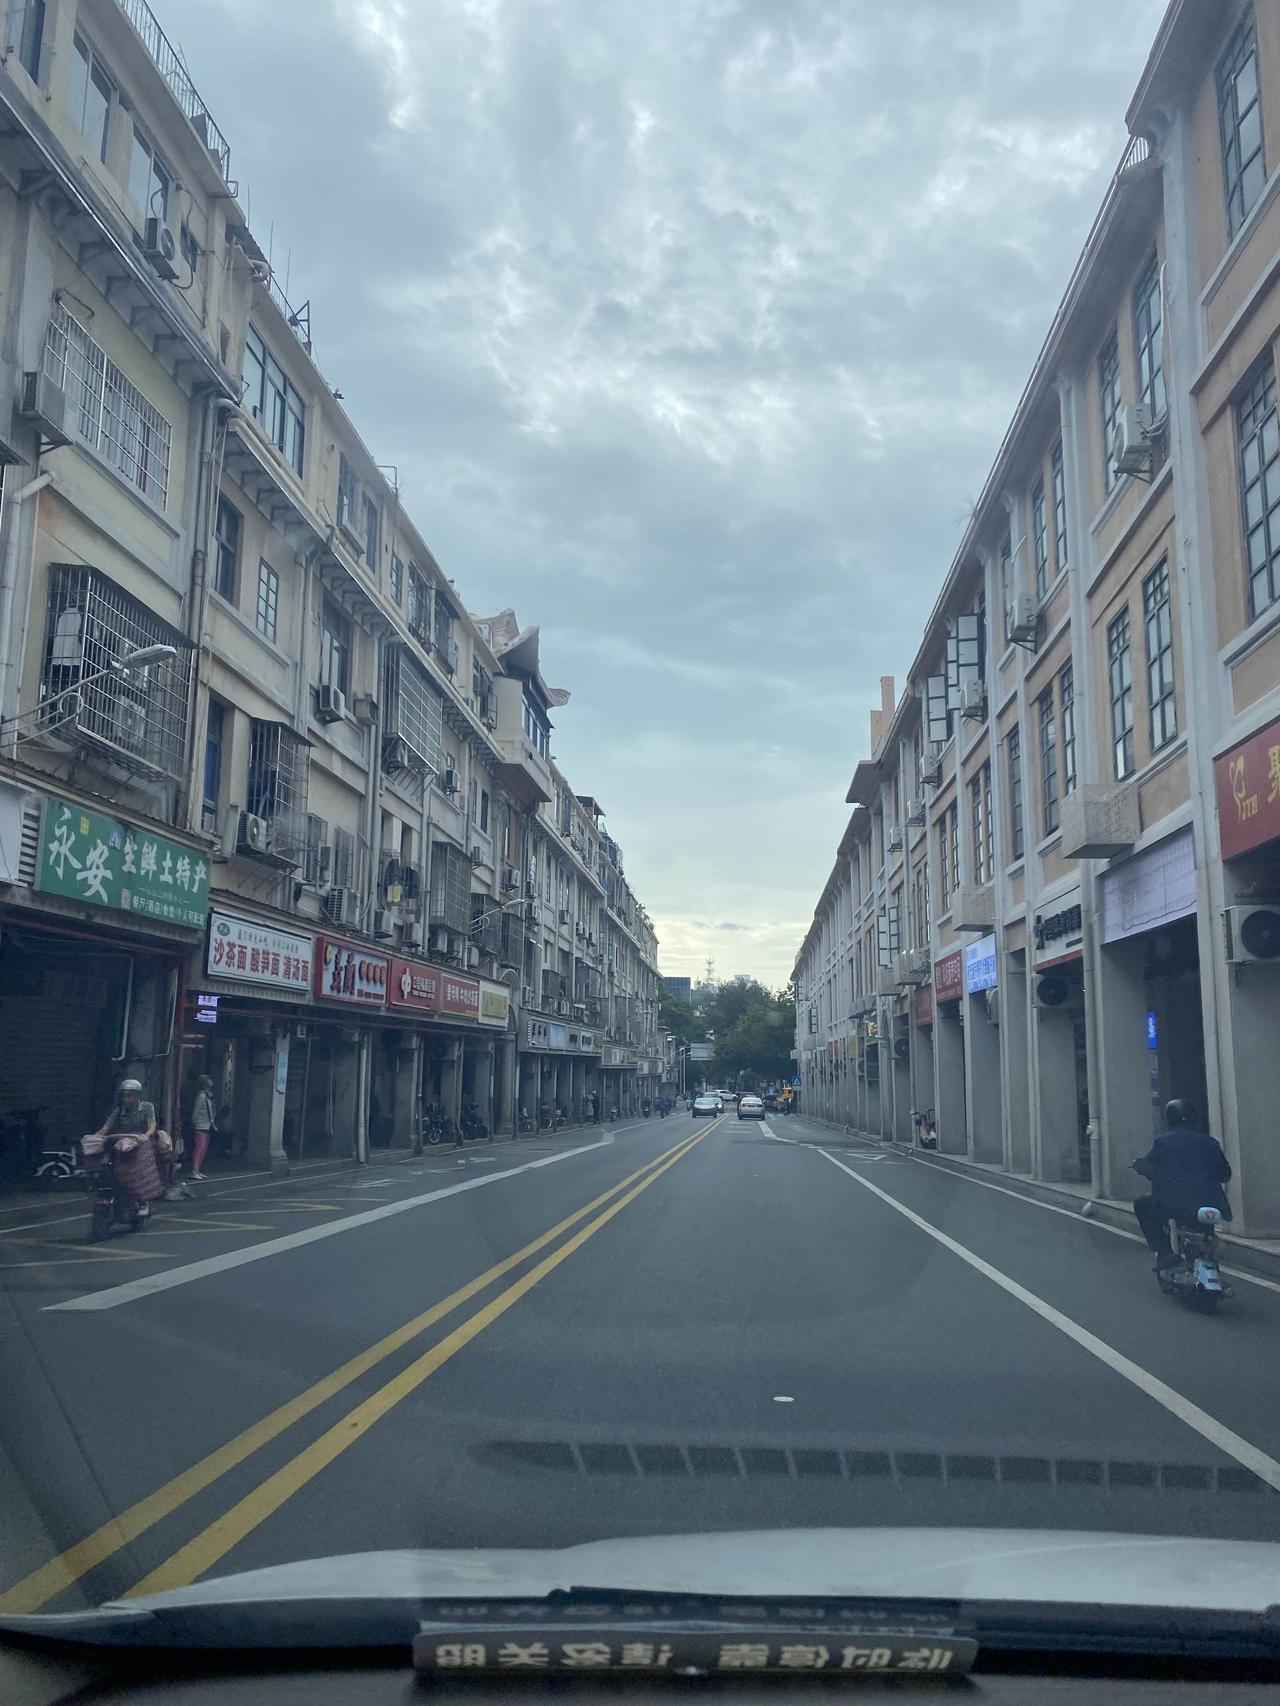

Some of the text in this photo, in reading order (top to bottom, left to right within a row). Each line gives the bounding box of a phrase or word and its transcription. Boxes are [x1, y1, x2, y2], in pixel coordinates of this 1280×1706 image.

[48, 807, 208, 904] 永安 生鲜土特产
[213, 937, 248, 971] 沙茶面
[250, 946, 280, 976] 酸笋面
[282, 955, 310, 983] 清汤面
